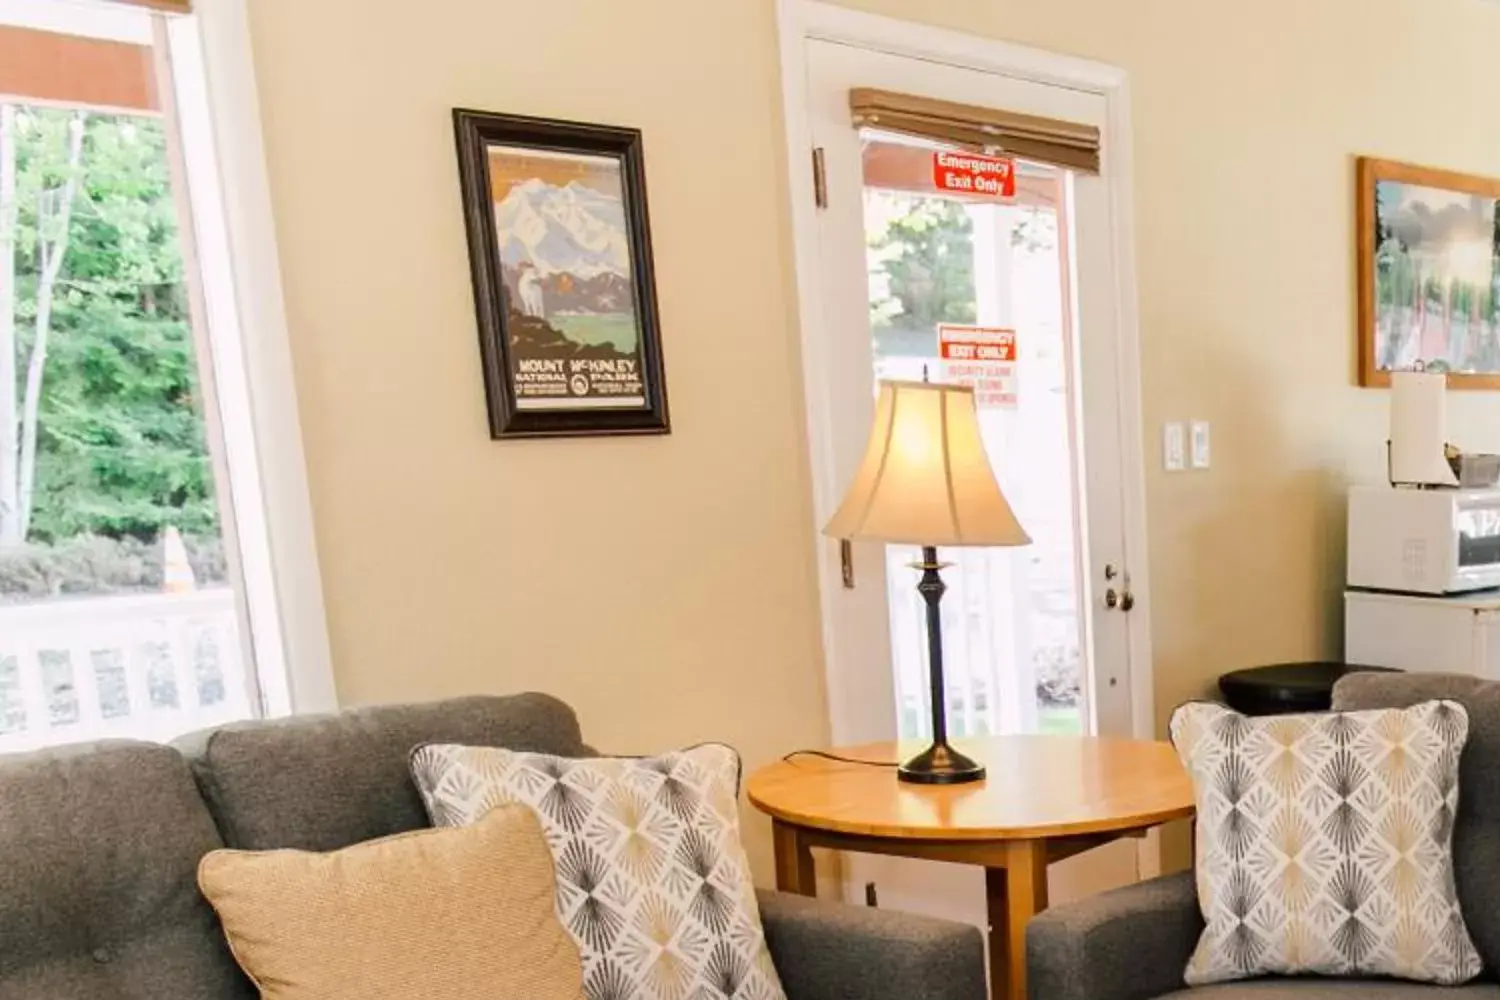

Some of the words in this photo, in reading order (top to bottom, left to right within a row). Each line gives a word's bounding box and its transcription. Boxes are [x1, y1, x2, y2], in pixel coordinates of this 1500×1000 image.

[938, 152, 1009, 178] Emergency
[945, 172, 971, 189] Exit
[975, 176, 1004, 196] Only
[519, 359, 564, 373] MOUNT
[515, 373, 566, 382] NATIONAL
